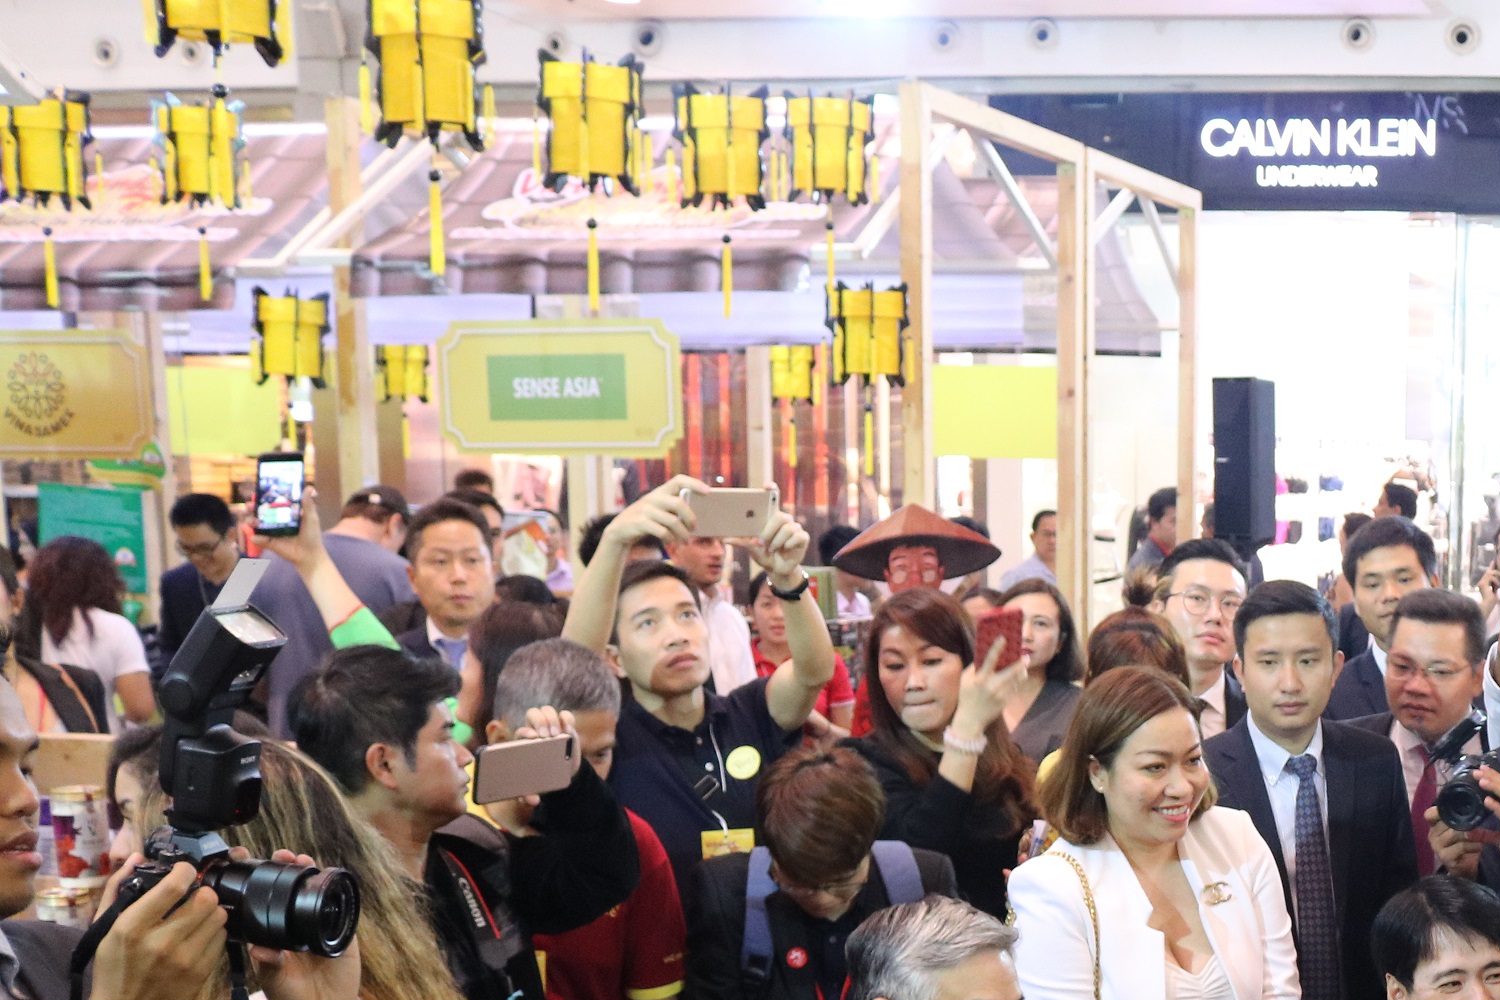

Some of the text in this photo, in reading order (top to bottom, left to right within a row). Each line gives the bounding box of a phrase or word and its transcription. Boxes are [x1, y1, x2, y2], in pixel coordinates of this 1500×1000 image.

[1201, 118, 1437, 158] CALVIN KLEIN
[1256, 164, 1379, 188] UNDERWEAR
[512, 376, 602, 399] SENSE ASIA
[458, 877, 487, 928] Canon
